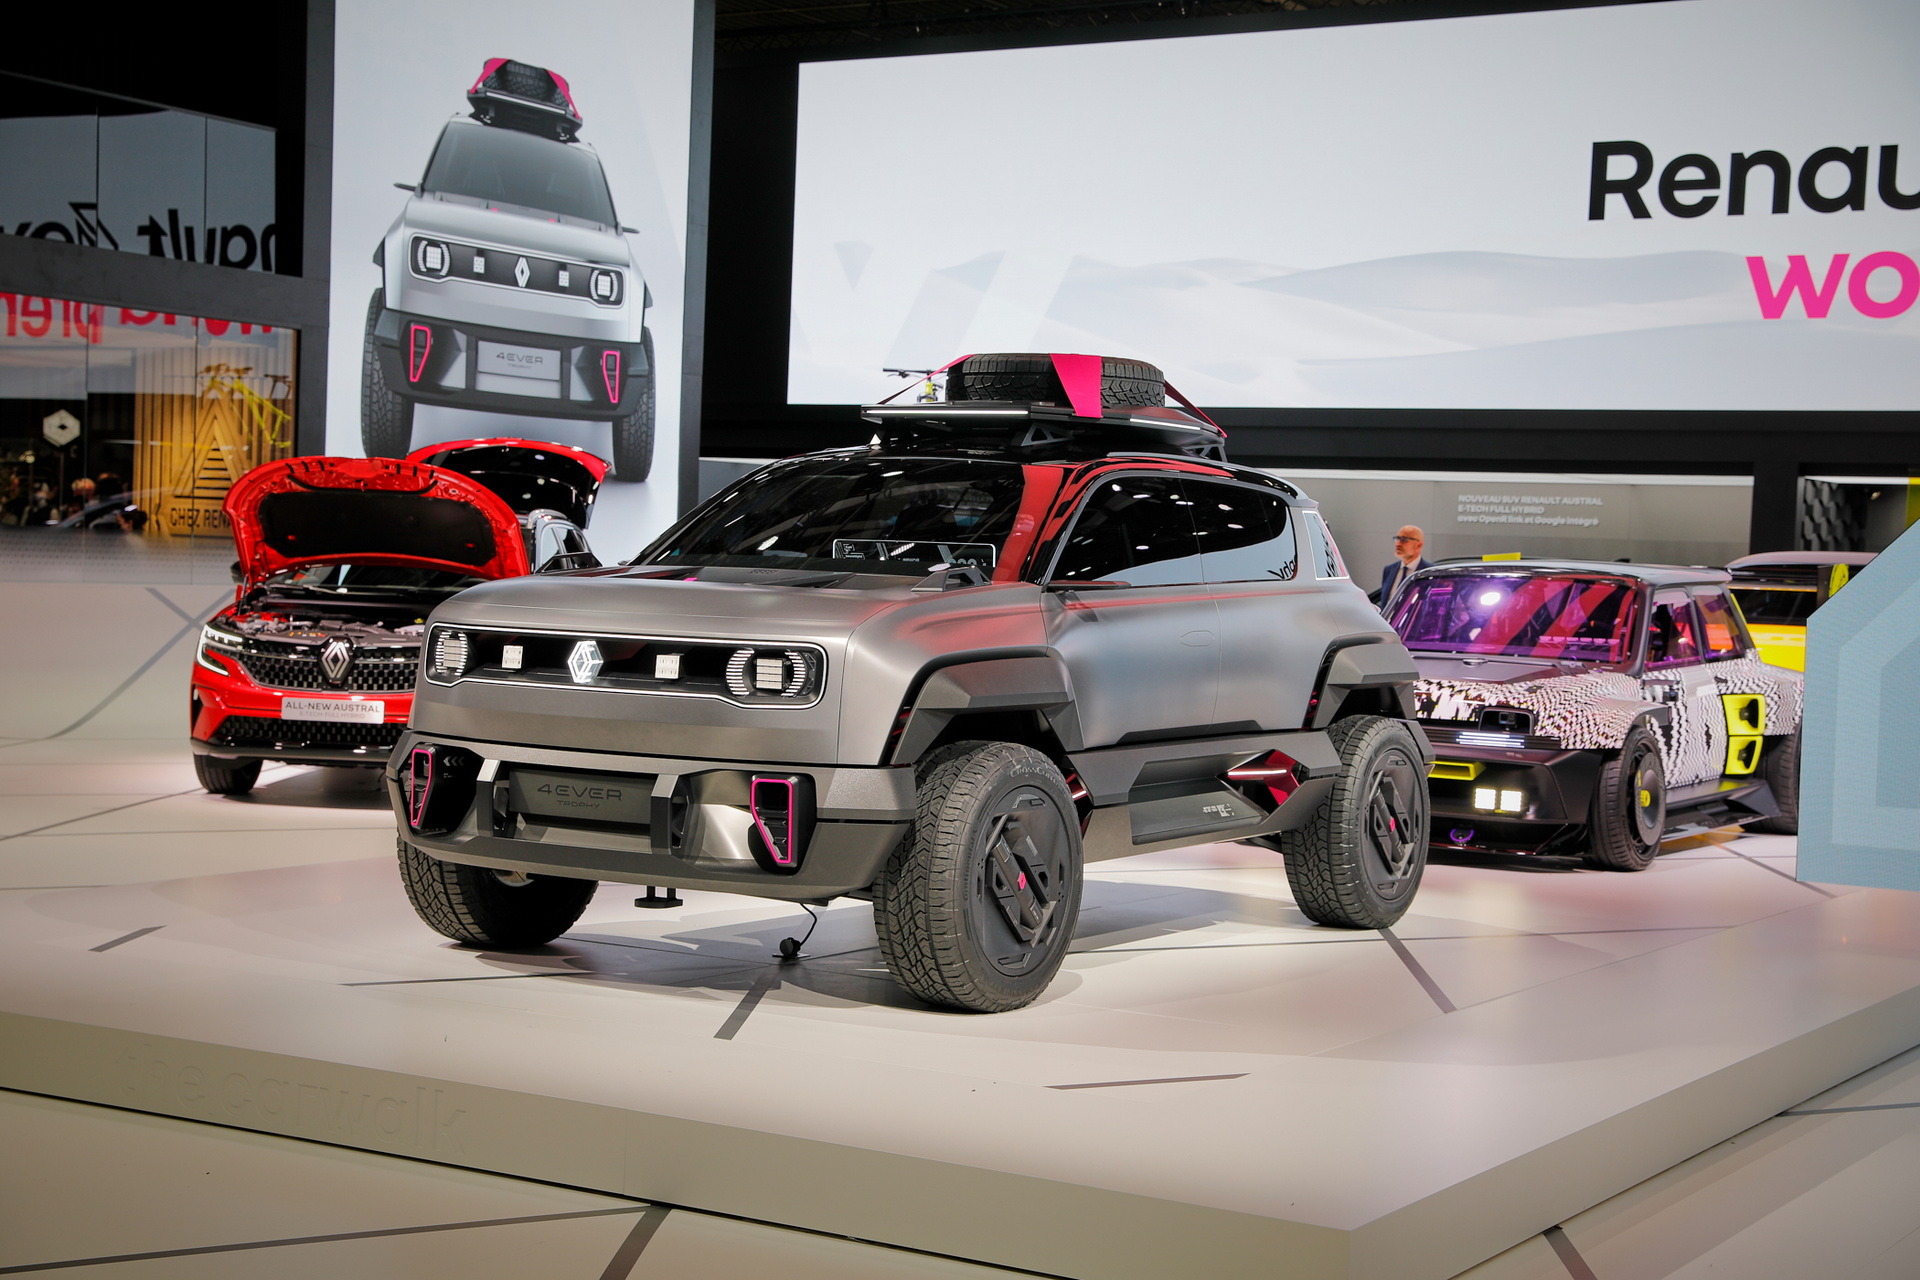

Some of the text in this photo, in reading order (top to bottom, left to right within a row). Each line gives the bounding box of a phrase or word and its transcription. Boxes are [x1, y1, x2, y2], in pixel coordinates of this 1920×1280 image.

[1588, 140, 1920, 220] Renau
[1745, 251, 1920, 319] wo
[496, 352, 544, 364] 4EVER
[1458, 495, 1500, 503] NOUVEAU
[1521, 496, 1561, 504] RENAULT
[1561, 497, 1603, 505] AUSTRAL
[1458, 504, 1544, 514] E-TECH FULL HYBRID
[171, 508, 200, 527] CHEZ
[1508, 515, 1523, 523] link
[1534, 516, 1566, 527] Google
[285, 701, 380, 712] ALL-NEW AUSTRAL
[537, 784, 622, 800] 4EVER
[557, 800, 600, 809] TROPHY
